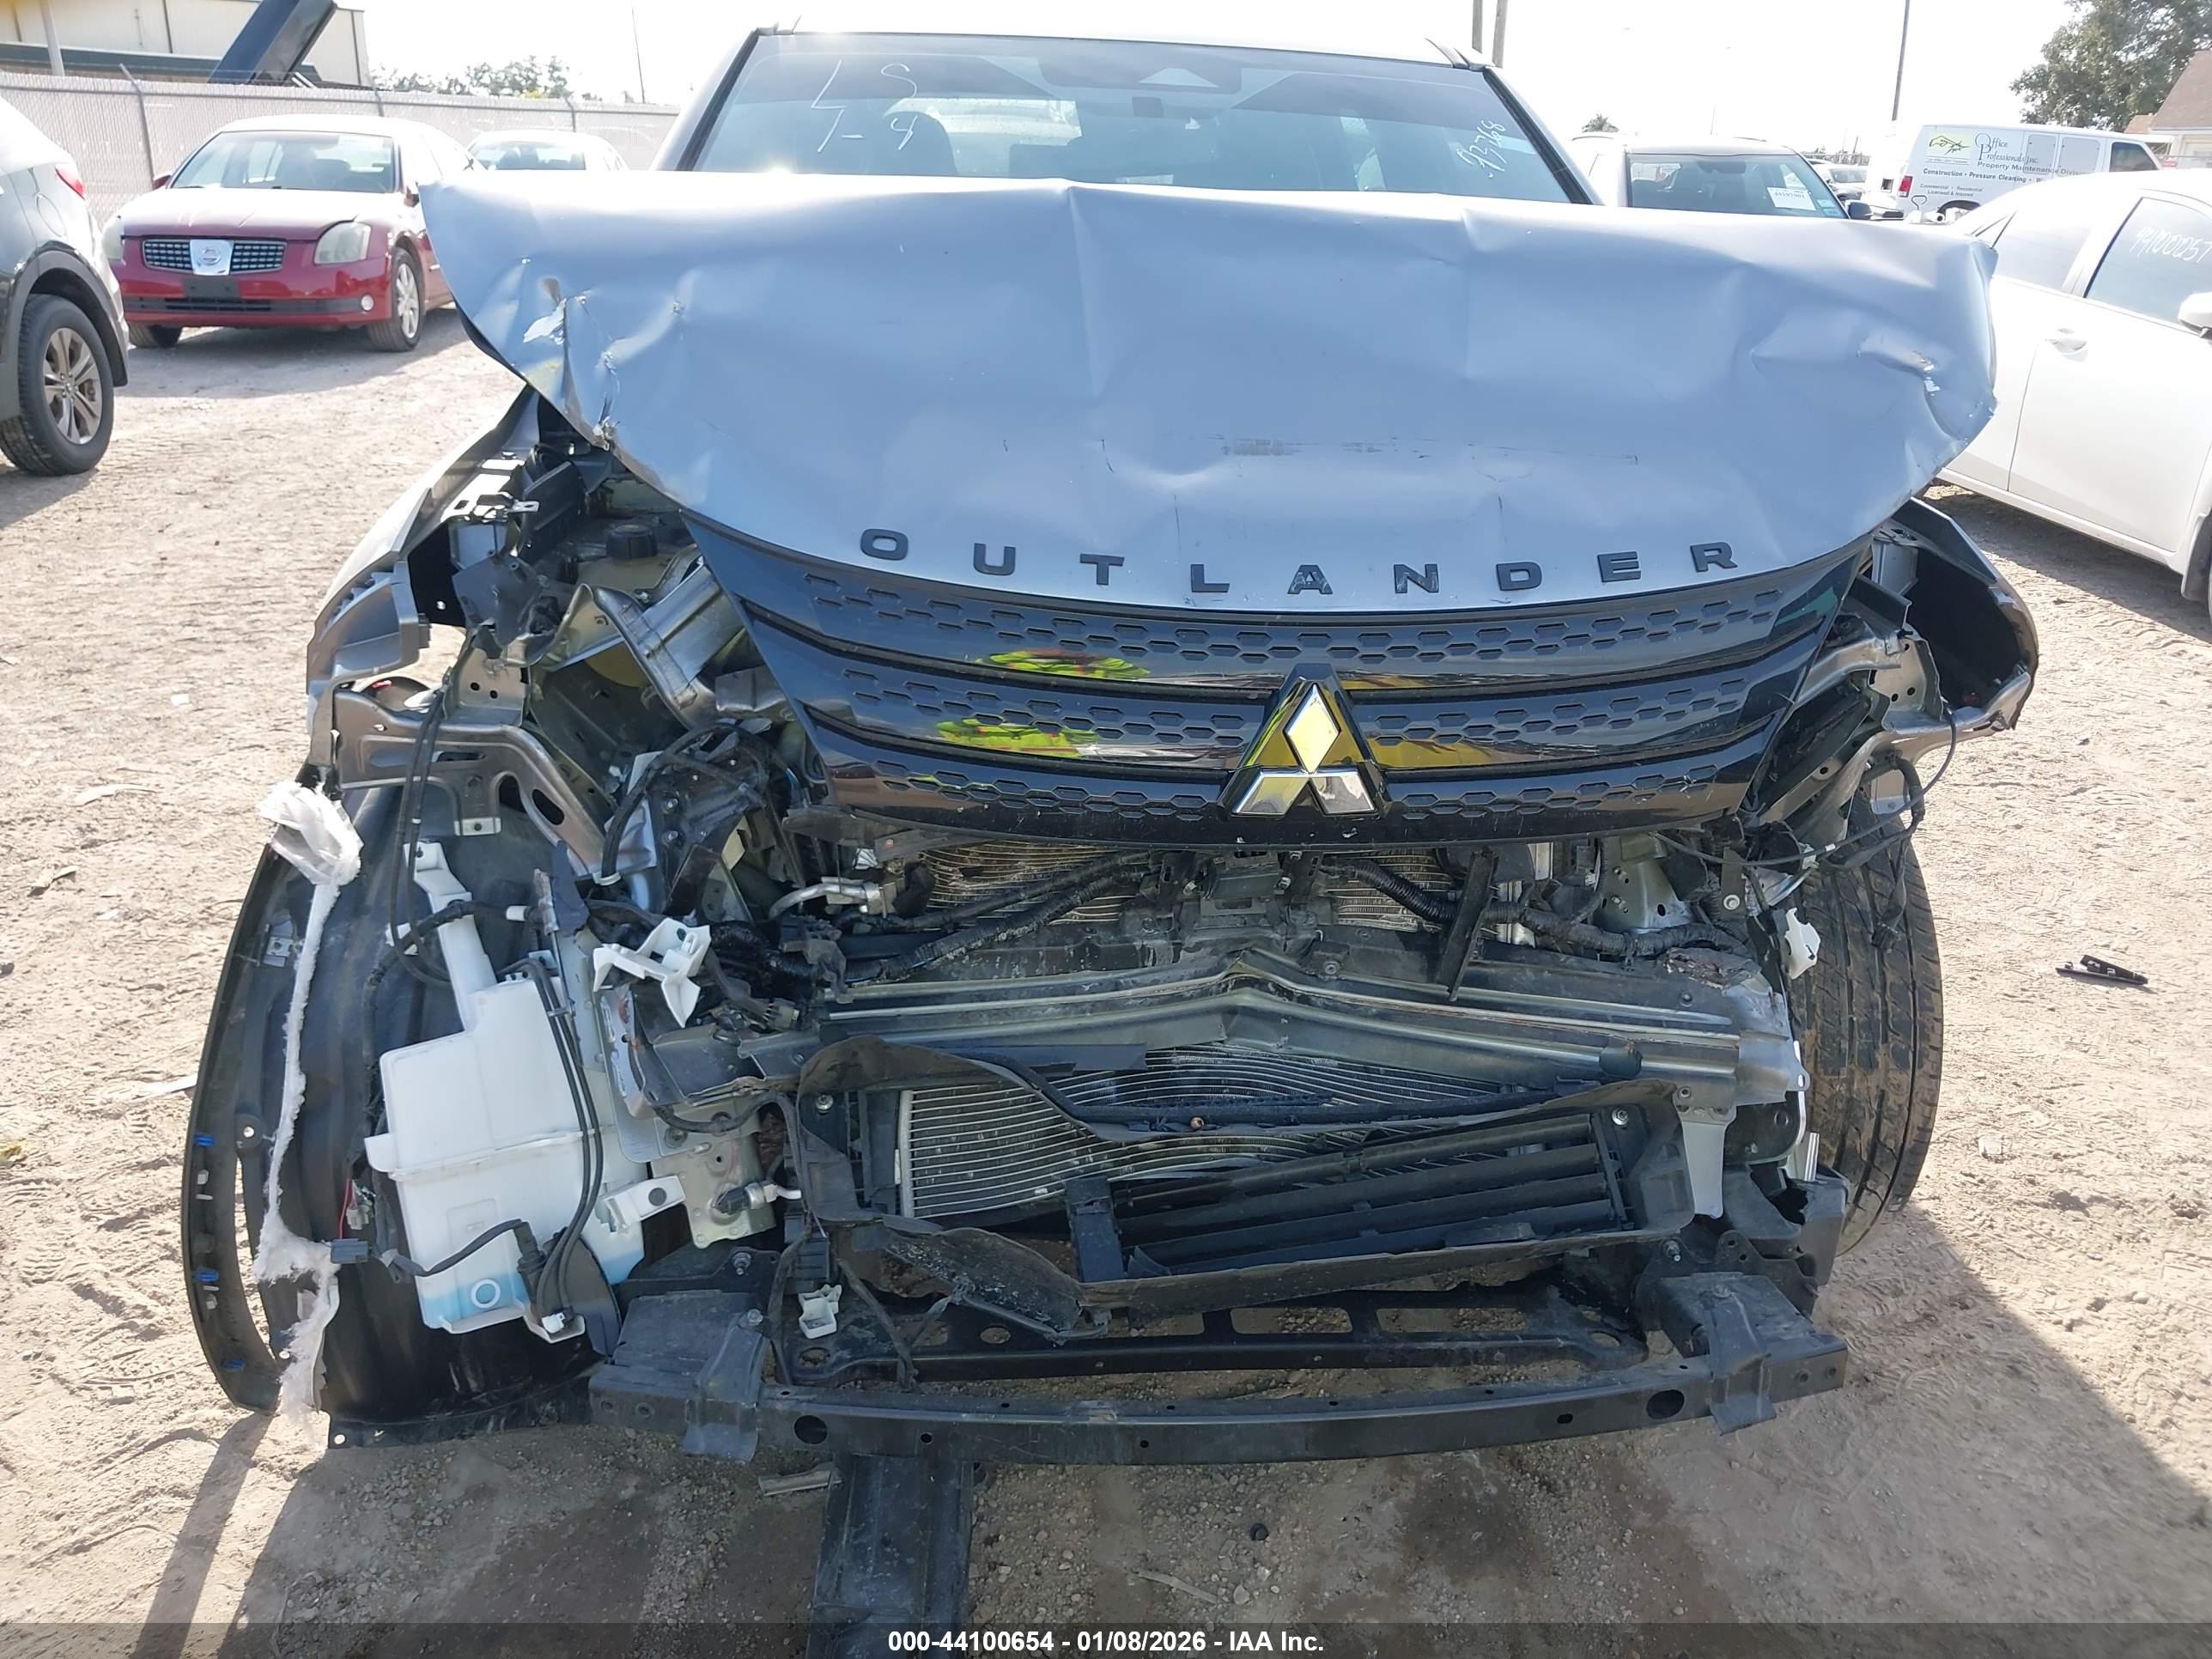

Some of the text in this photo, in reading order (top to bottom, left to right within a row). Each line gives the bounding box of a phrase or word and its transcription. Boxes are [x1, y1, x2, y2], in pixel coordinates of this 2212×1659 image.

[1975, 133, 2008, 148] Office
[1978, 143, 2024, 162] Professionals
[1923, 167, 1963, 177] Construction
[1969, 171, 1996, 179] Pressure
[1998, 174, 2027, 183] Cleaning
[1978, 161, 2010, 171] Property
[2011, 164, 2058, 174] Maintenance
[860, 528, 1738, 594] OUTLANDER
